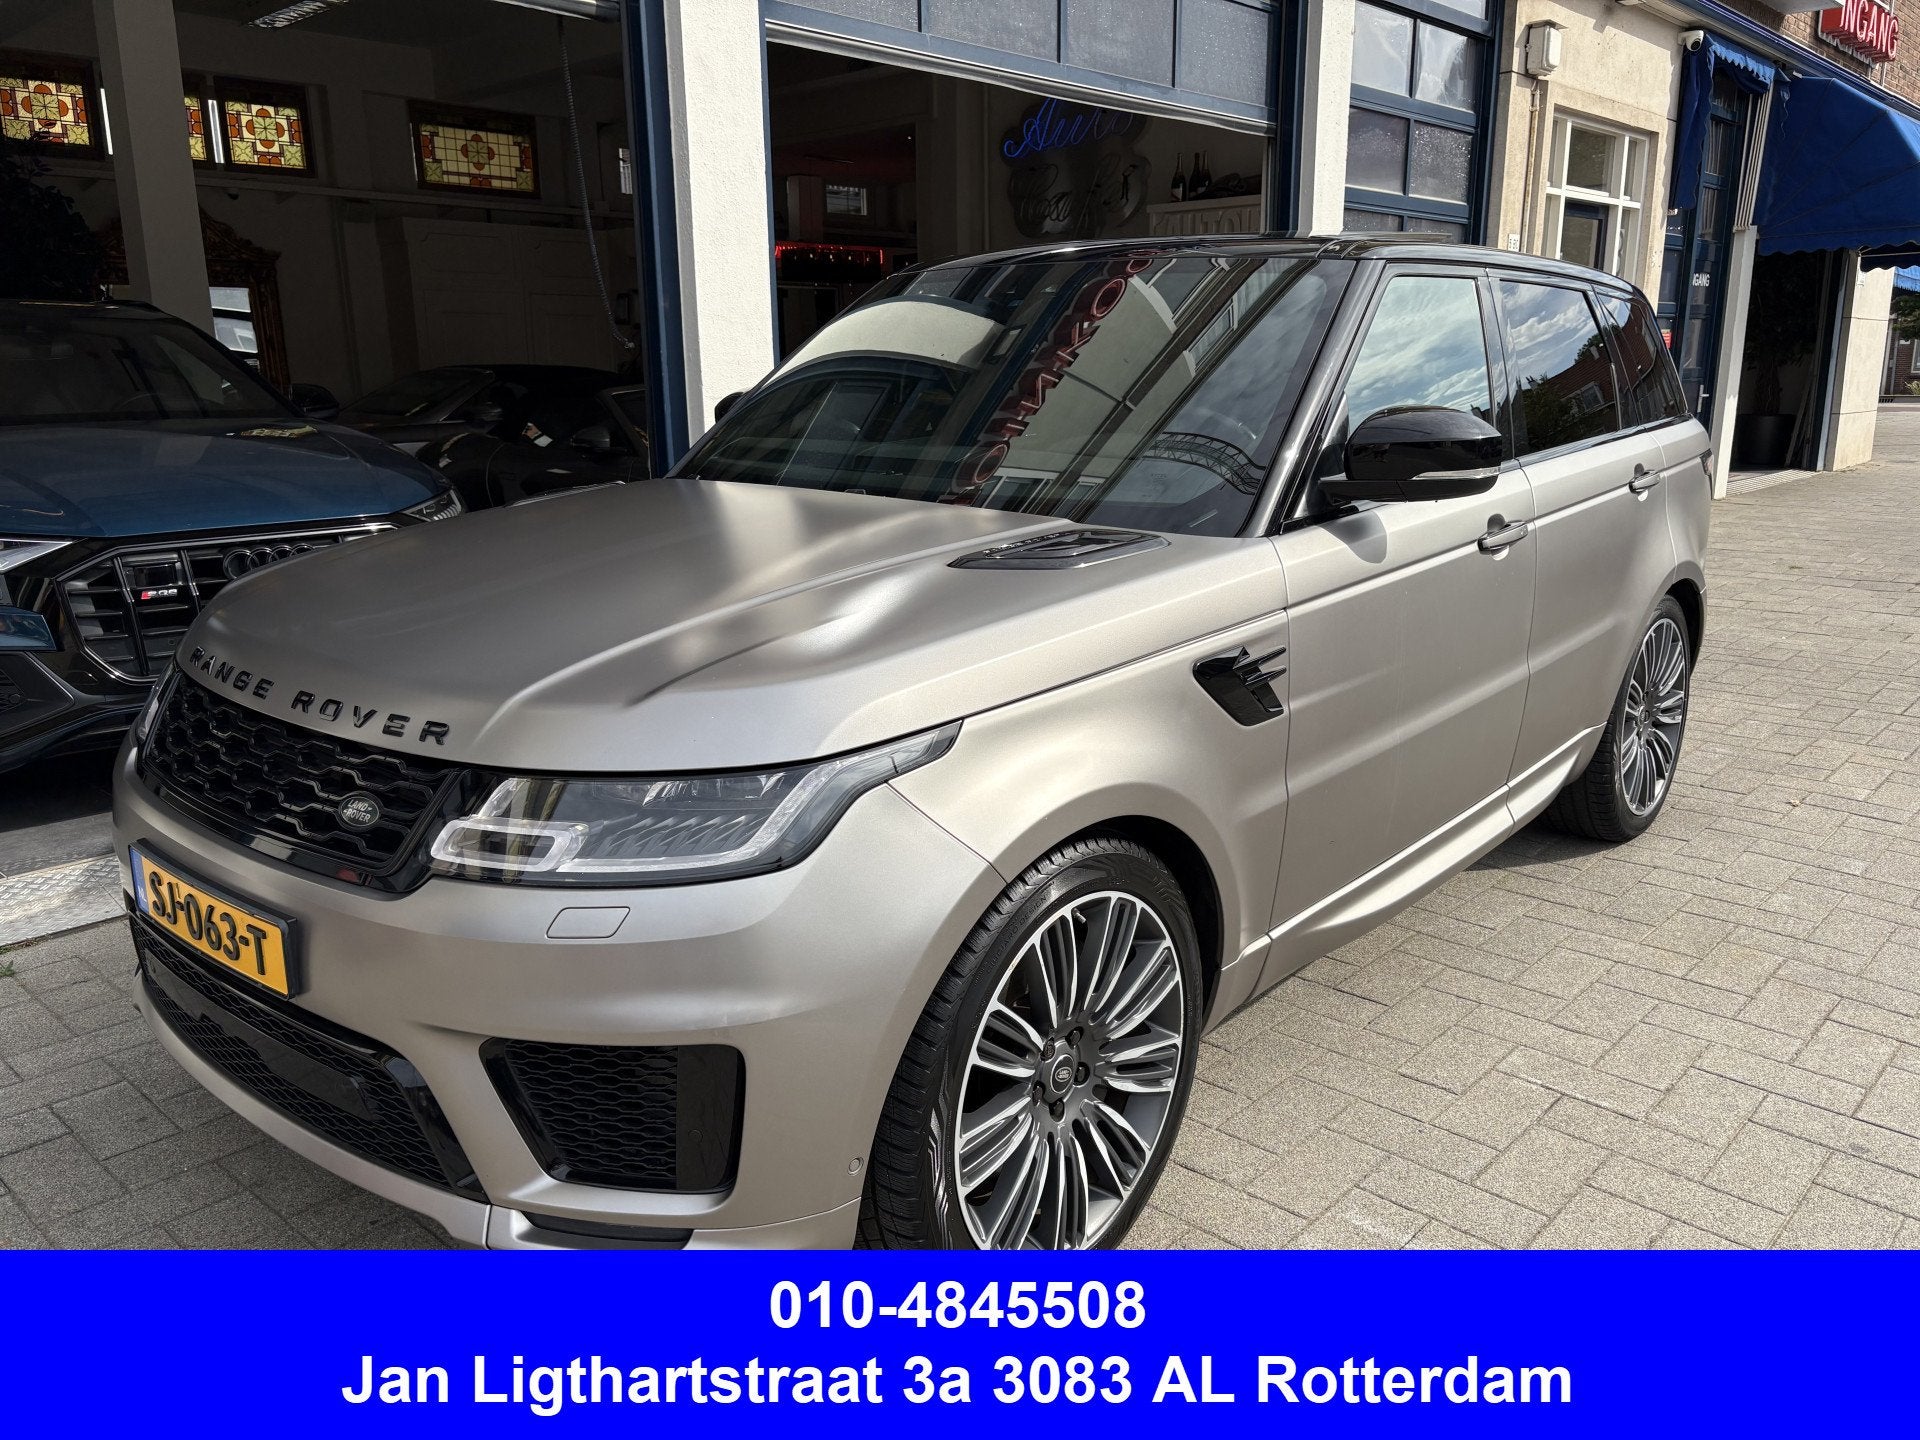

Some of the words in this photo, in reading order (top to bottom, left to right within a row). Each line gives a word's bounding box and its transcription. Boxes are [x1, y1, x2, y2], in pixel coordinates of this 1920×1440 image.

[1839, 0, 1900, 59] INGANG
[190, 646, 274, 699] RANGE
[291, 690, 451, 745] ROVER
[345, 808, 371, 823] ROVER
[347, 799, 369, 812] LAND
[148, 870, 268, 976] SJ-063-T
